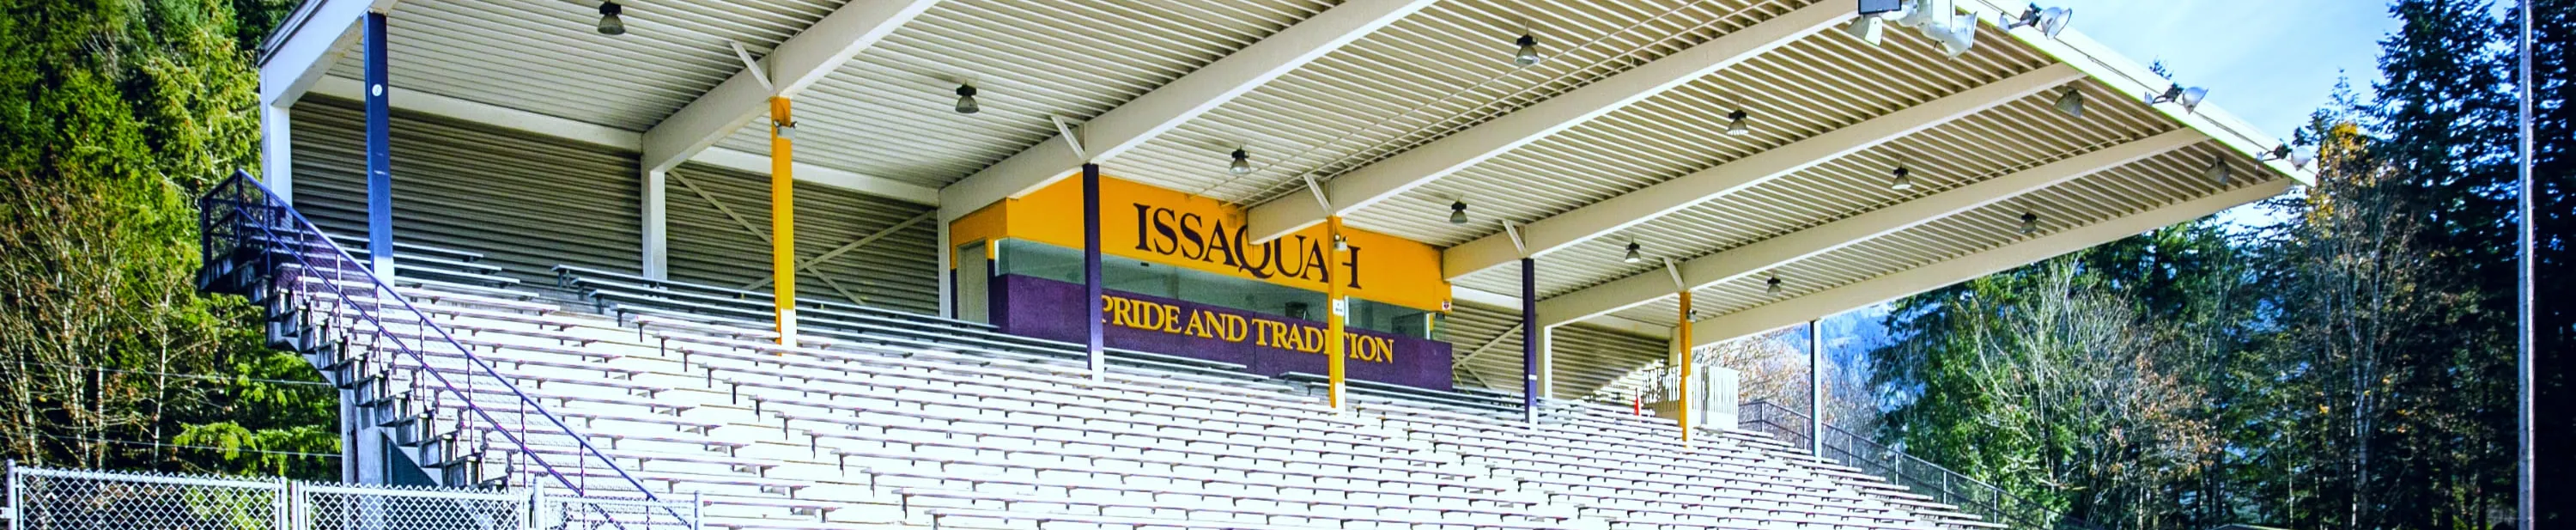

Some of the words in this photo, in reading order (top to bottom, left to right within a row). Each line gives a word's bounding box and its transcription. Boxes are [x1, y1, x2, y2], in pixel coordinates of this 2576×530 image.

[1133, 203, 1362, 289] ISSAQUAH
[1101, 295, 1182, 333] PRIDE
[1184, 308, 1248, 342] AND
[1251, 318, 1394, 364] TRADIION
